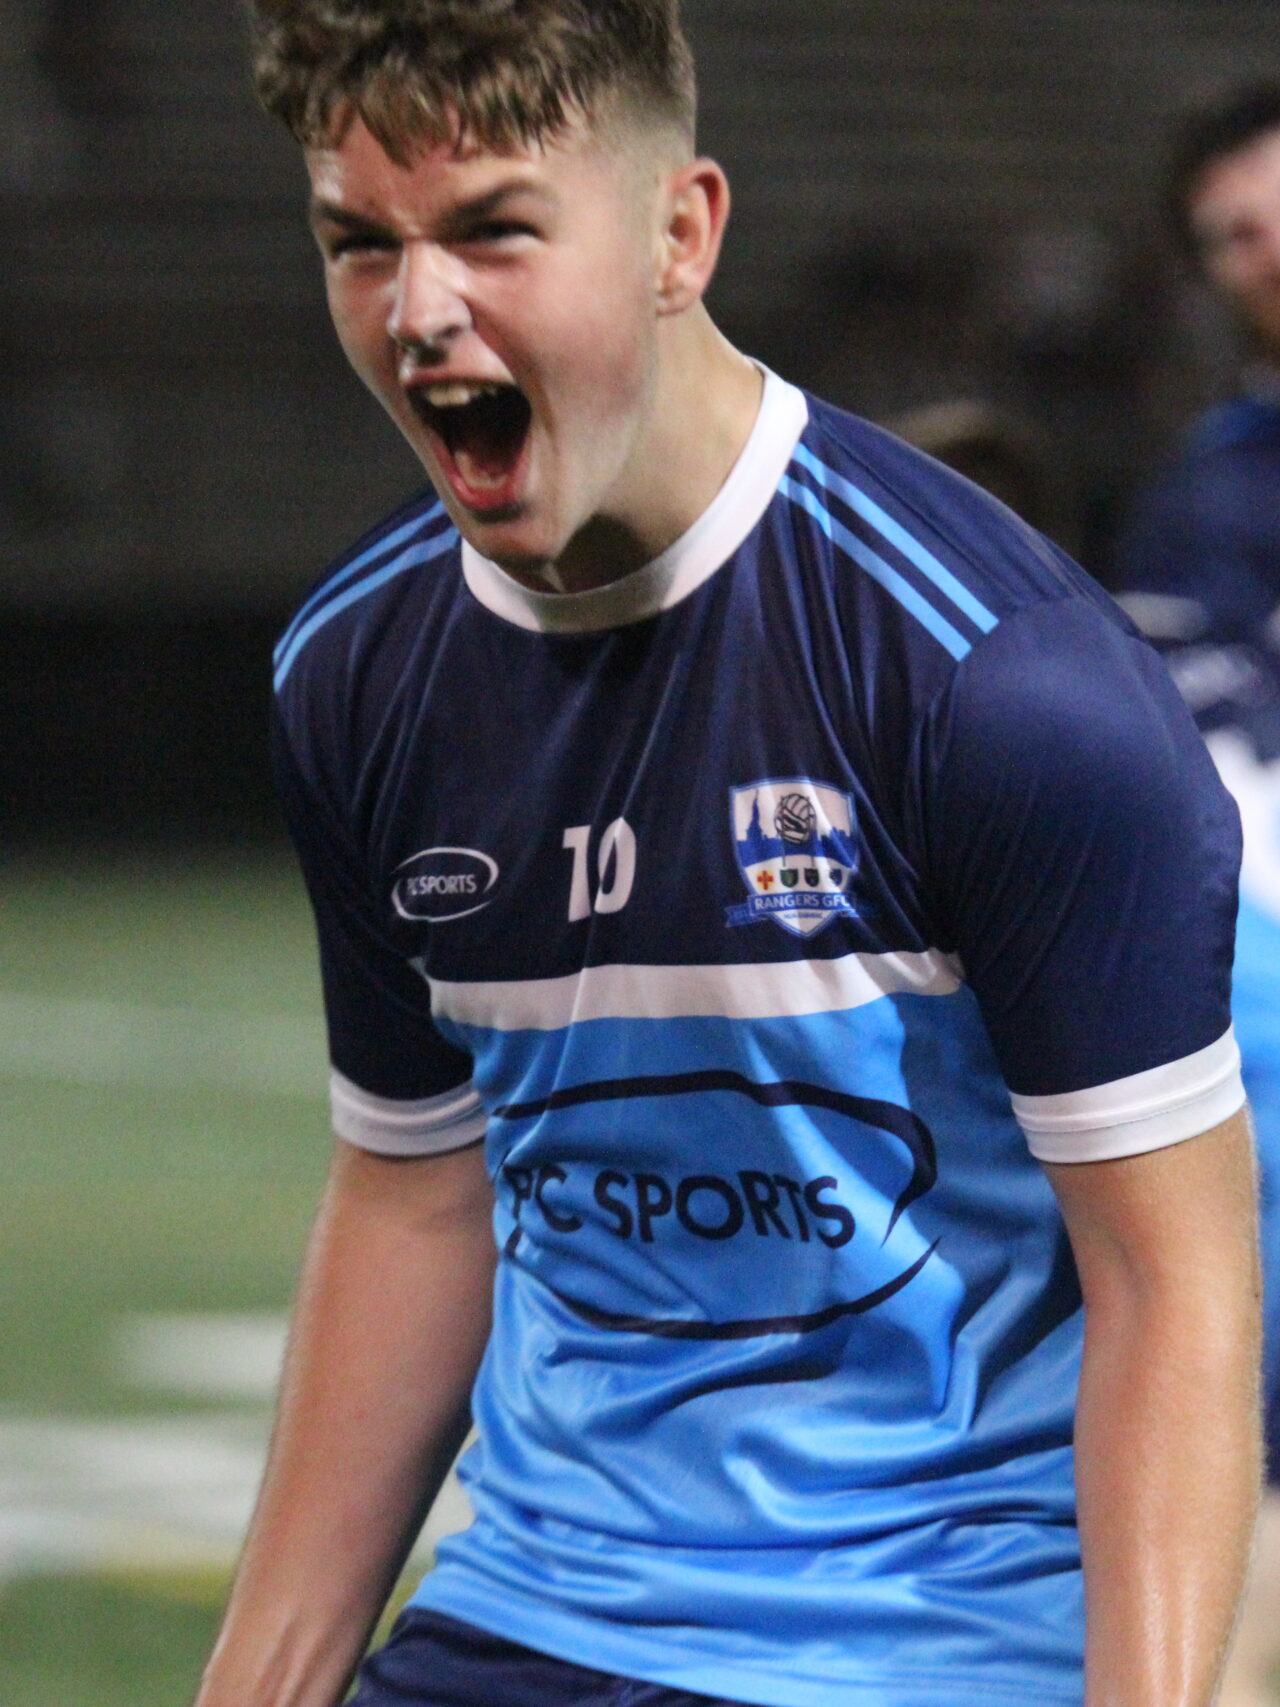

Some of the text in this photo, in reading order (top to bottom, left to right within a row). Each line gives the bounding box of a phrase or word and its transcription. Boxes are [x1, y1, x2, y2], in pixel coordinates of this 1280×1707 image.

[419, 874, 477, 895] SPORTS
[562, 816, 637, 922] 10
[754, 893, 820, 911] RANGERS
[503, 1164, 856, 1249] PC SPORTS
